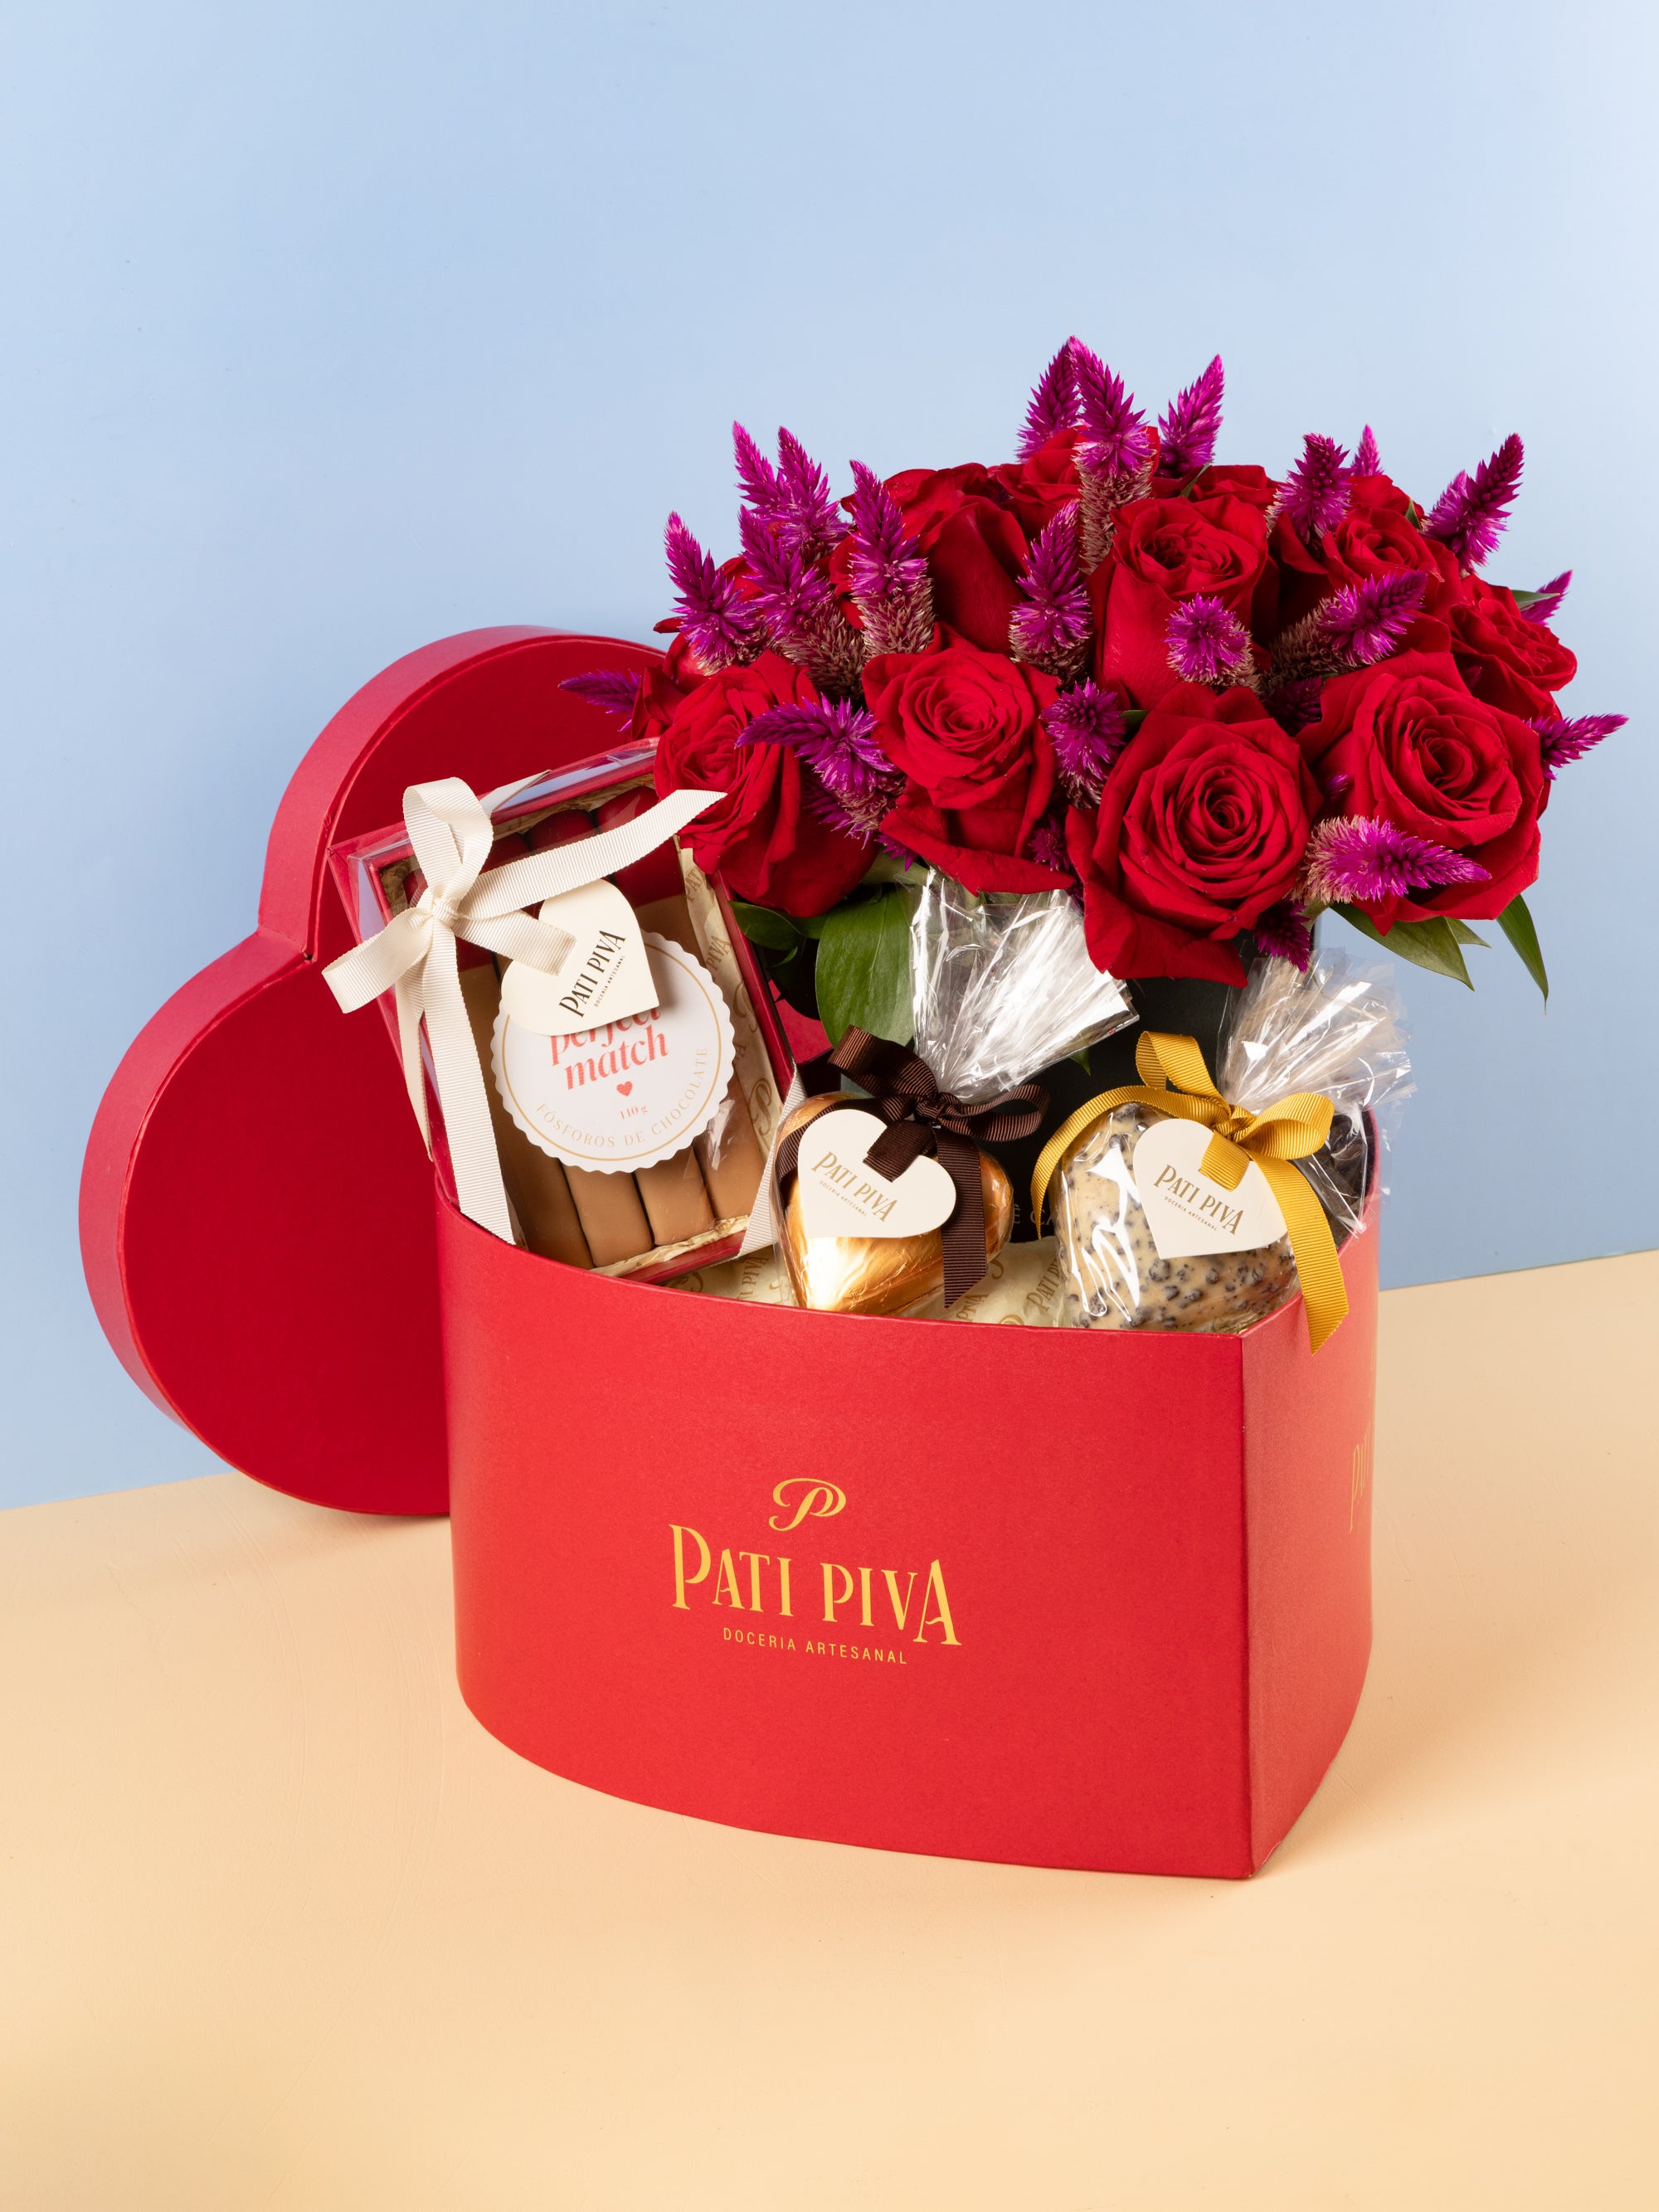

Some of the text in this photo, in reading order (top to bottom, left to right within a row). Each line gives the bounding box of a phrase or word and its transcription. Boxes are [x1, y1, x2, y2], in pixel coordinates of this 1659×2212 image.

[559, 931, 626, 1018] PATI PIVA
[594, 955, 625, 1007] DOCERIA ARTESANAL
[564, 1024, 669, 1090] match
[537, 1048, 708, 1148] FÓSFOROS DE CHOCOLATE
[620, 1106, 649, 1120] 110 g
[811, 1151, 898, 1222] PATI PIVA
[1153, 1164, 1243, 1234] PATI PIVA
[1164, 1196, 1217, 1231] DOCERIA ARTESANAL
[1026, 1276, 1059, 1312] PATI
[669, 1524, 962, 1646] PATI PIVA
[723, 1627, 907, 1665] DOCERIA ARTESANAL
